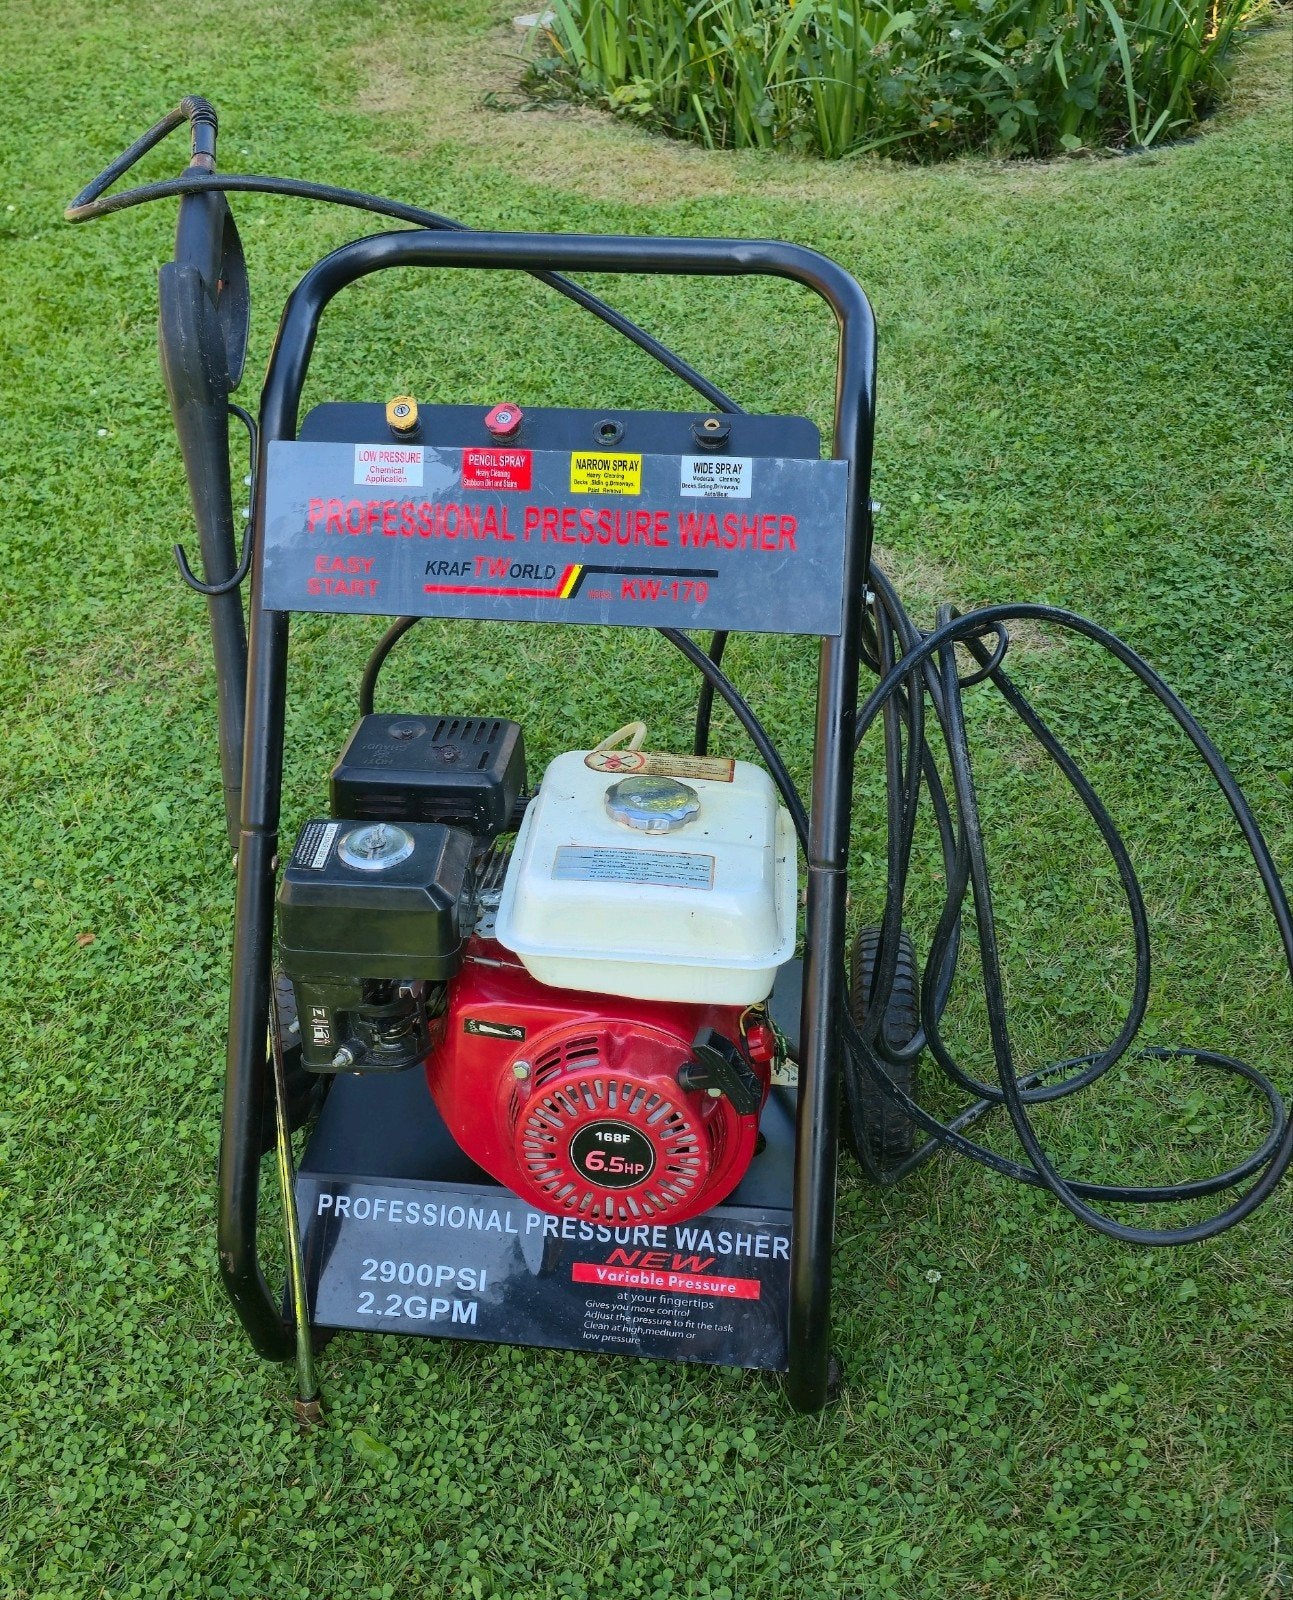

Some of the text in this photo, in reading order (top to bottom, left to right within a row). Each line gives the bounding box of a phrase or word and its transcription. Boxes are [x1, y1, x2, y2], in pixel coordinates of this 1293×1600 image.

[358, 450, 421, 464] LOW PRESSURE
[468, 454, 526, 468] PENCIL SPRAY
[576, 459, 610, 471] NARROW
[369, 466, 404, 474] Chemical
[475, 469, 510, 479] Heavy Cleaning
[693, 462, 743, 474] WIDE SPRAY
[365, 475, 407, 484] Application
[307, 497, 798, 551] PROFESSIONAL PRESSURE WASHER
[314, 554, 375, 575] EASY
[306, 577, 380, 597] START
[620, 578, 709, 604] KW-170
[595, 1131, 631, 1144] 168F
[585, 1150, 645, 1175] 6.5HP
[317, 1193, 790, 1260] PROFESSIONAL PRESSURE WASHER
[606, 1248, 716, 1272] NEW
[360, 1258, 487, 1292] 2900PSI
[596, 1268, 737, 1294] Variable Pressure
[356, 1291, 478, 1325] 2.2GPM
[585, 1300, 690, 1318] Gives you more control
[617, 1292, 714, 1310] at your fingertips
[584, 1310, 734, 1333] Adjust the pressure to fit the task
[584, 1320, 610, 1331] Clean
[611, 1324, 621, 1332] at
[582, 1332, 641, 1345] low pressure
